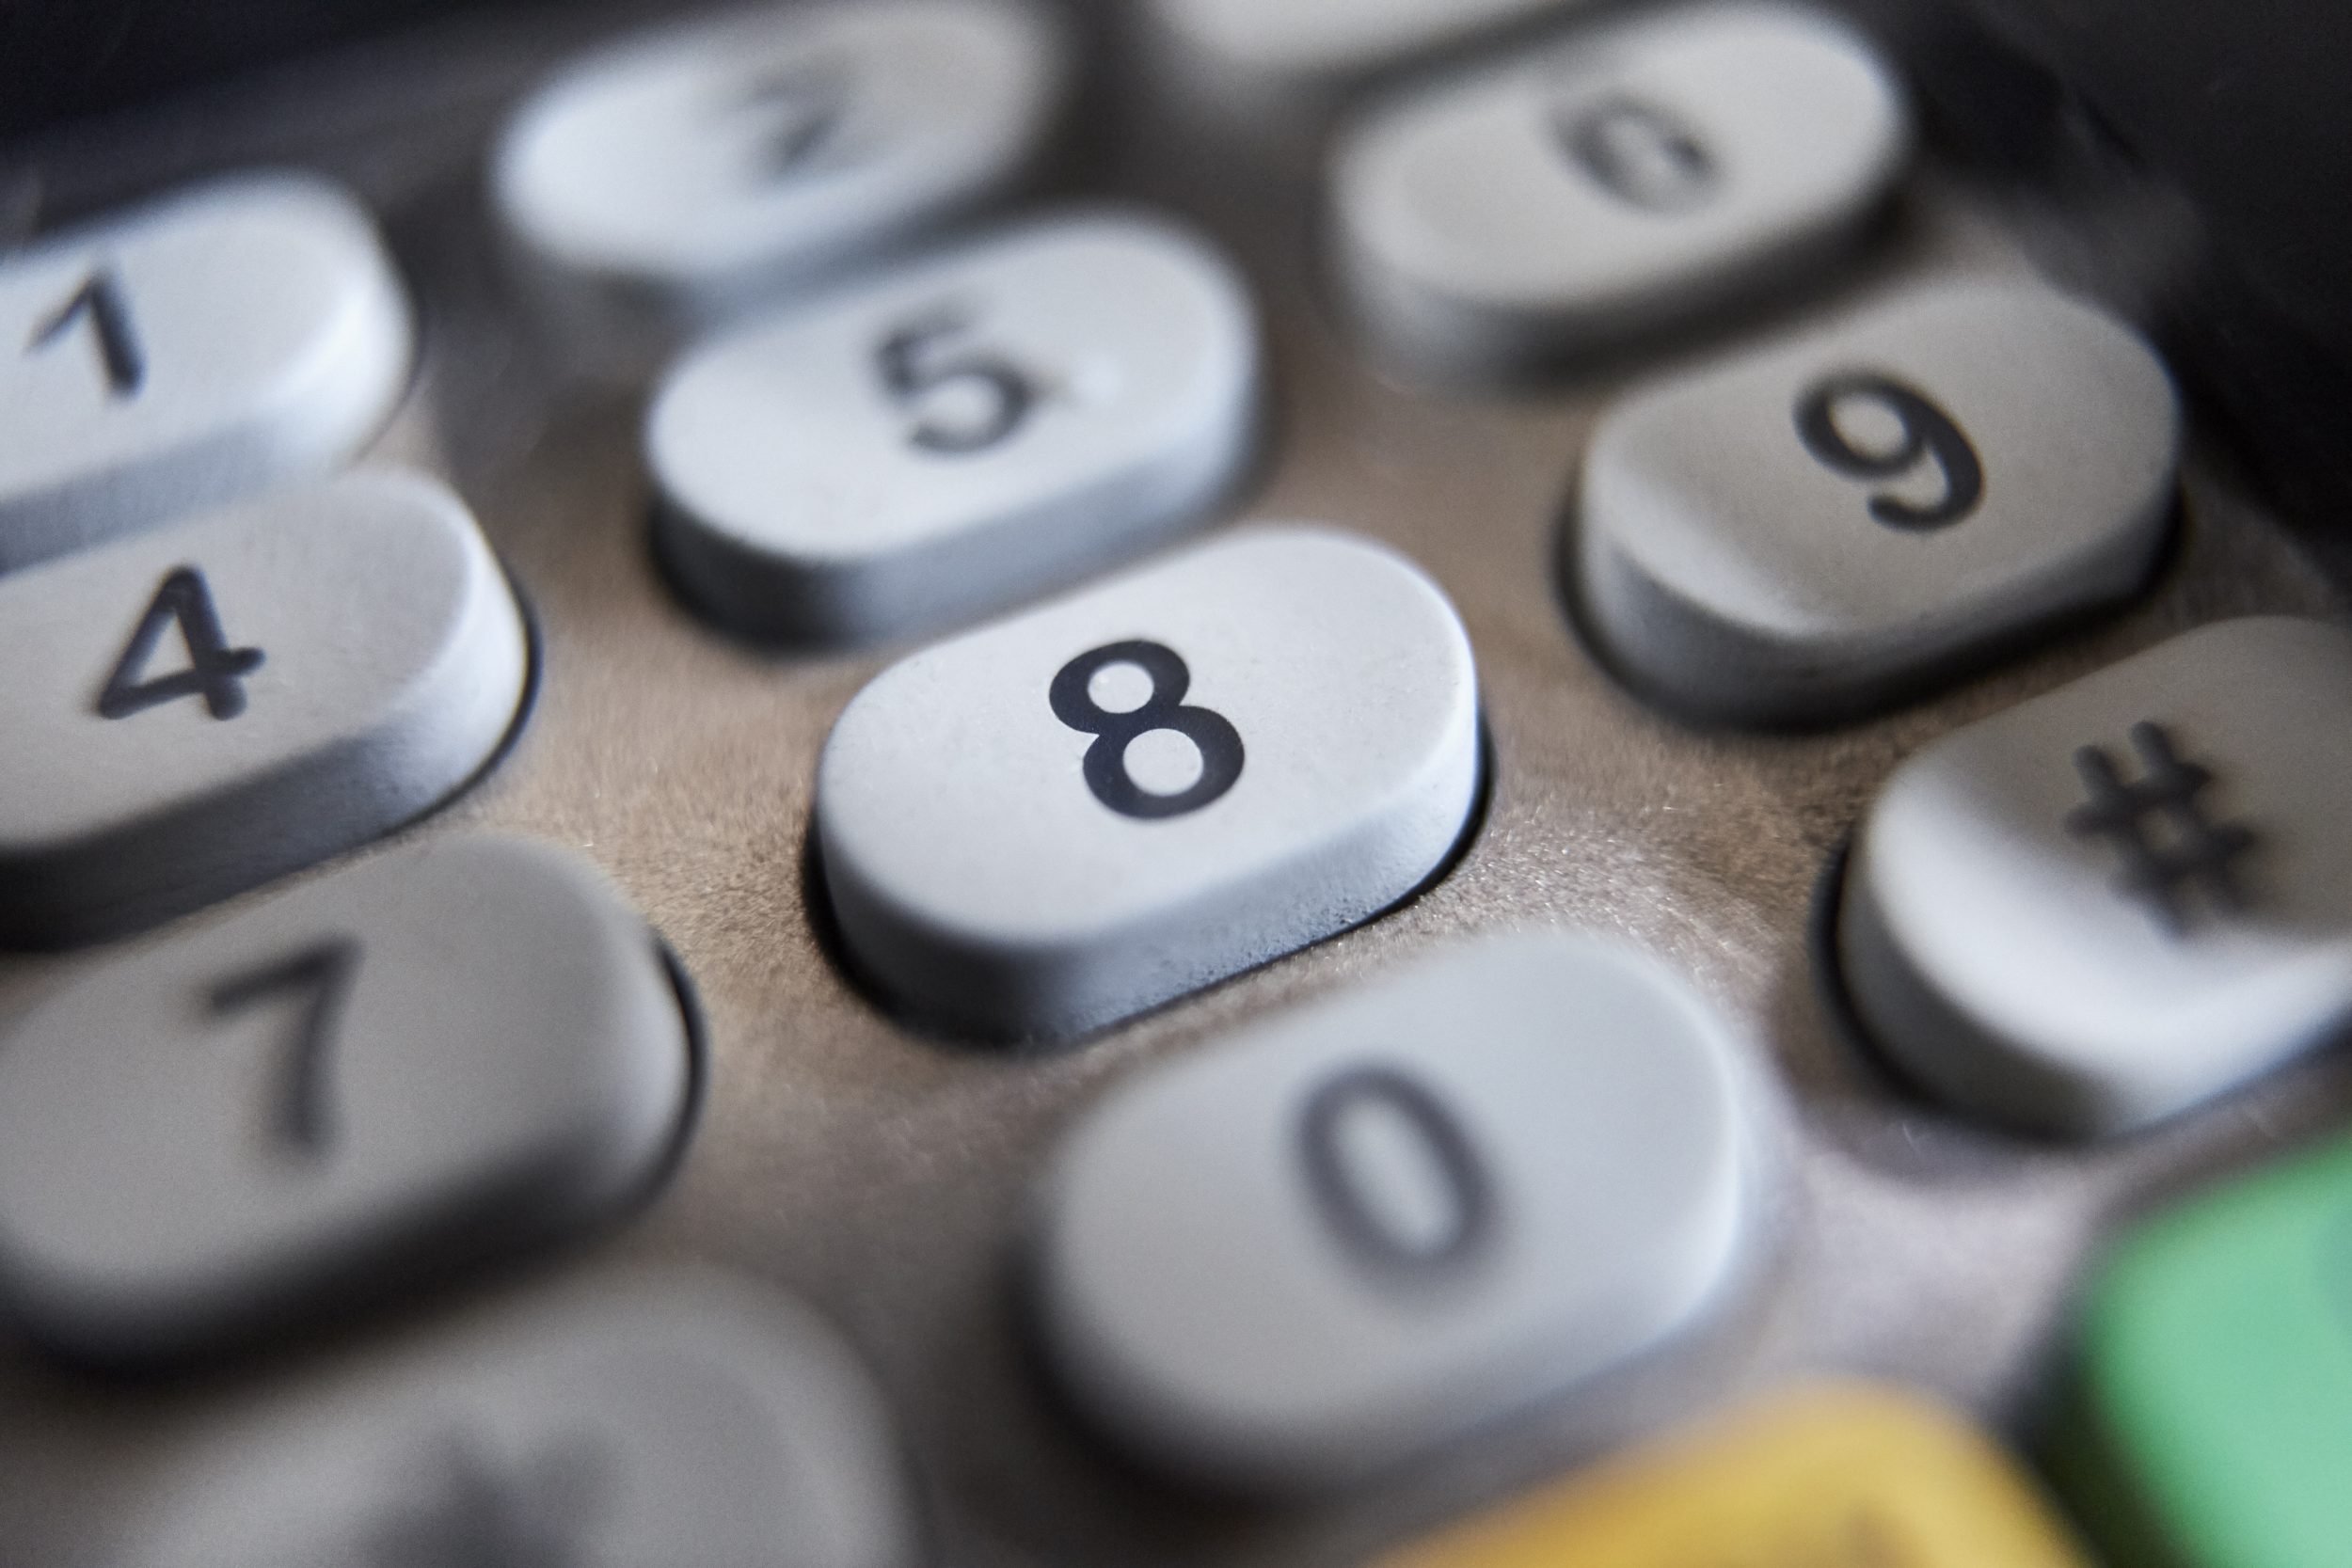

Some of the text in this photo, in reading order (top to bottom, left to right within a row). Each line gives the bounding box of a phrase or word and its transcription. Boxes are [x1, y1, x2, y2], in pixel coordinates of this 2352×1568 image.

[24, 268, 147, 400] 1
[871, 303, 1033, 458] 5
[1792, 372, 1984, 531] 9
[92, 566, 265, 721] 4
[1049, 639, 1245, 819] 8
[199, 931, 367, 1166] 7
[1291, 1061, 1502, 1287] 0
